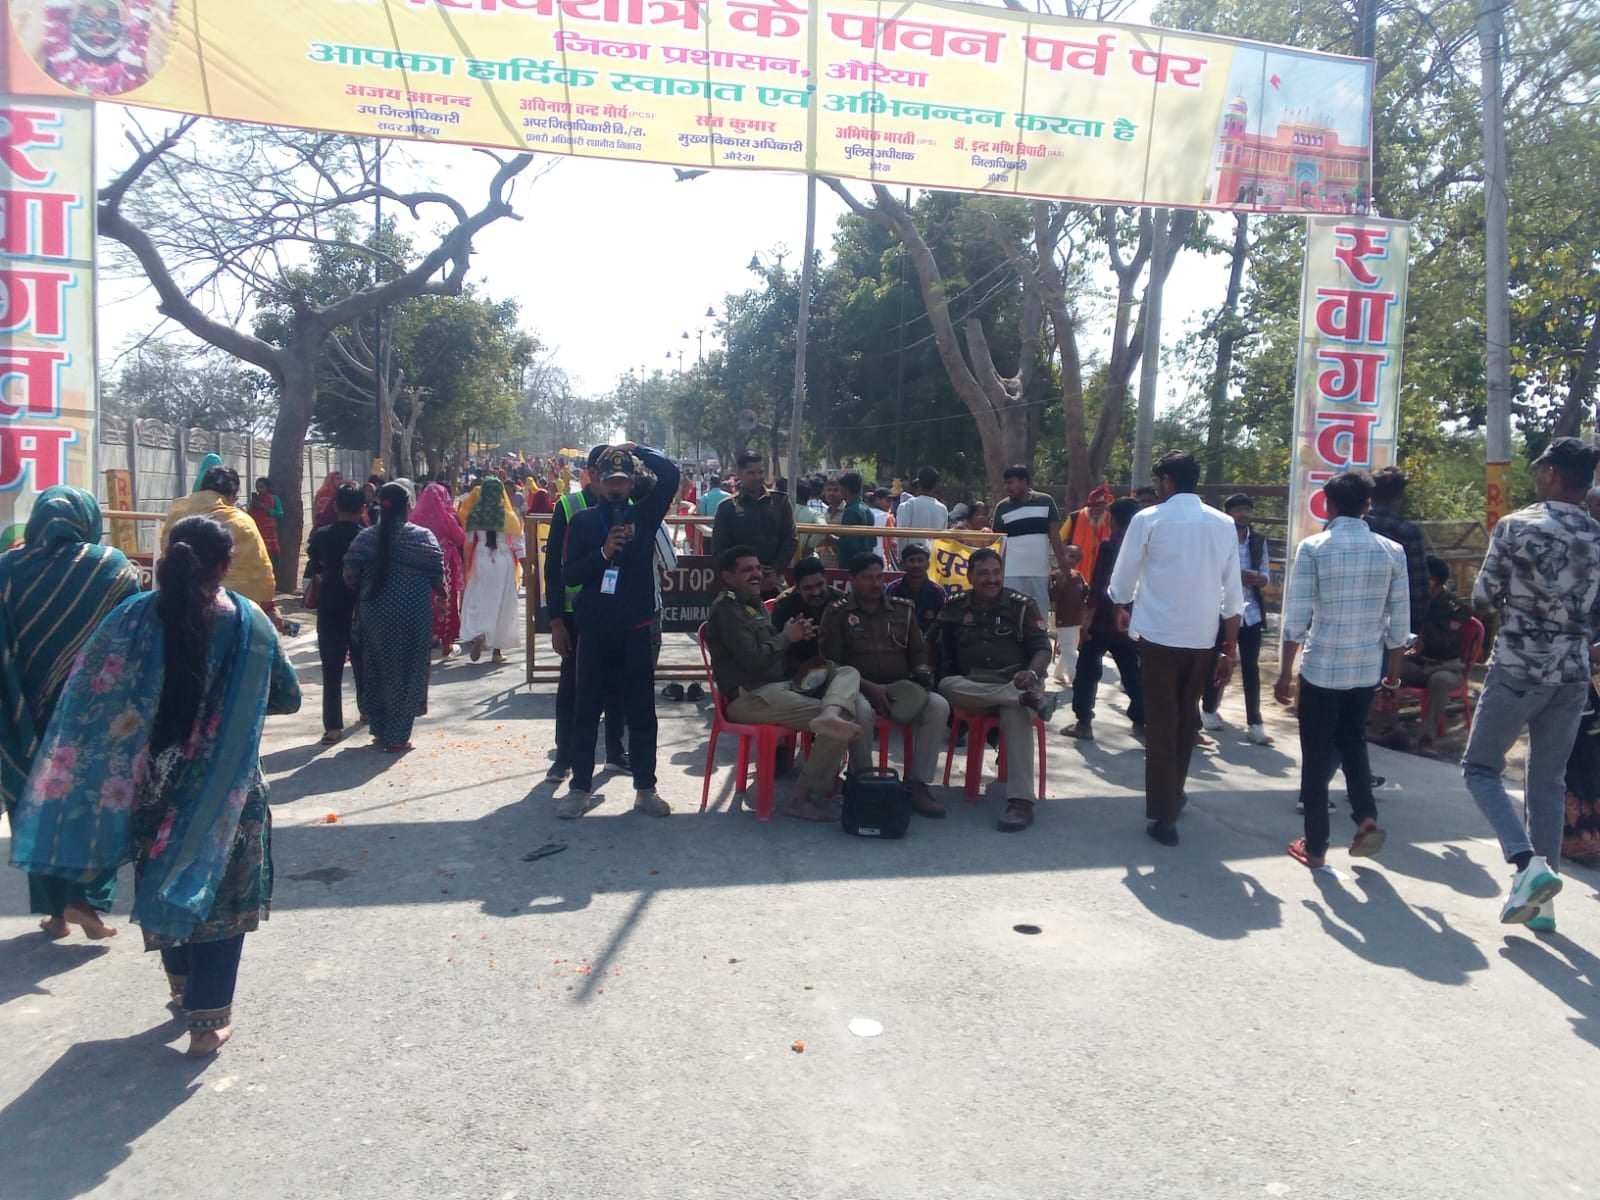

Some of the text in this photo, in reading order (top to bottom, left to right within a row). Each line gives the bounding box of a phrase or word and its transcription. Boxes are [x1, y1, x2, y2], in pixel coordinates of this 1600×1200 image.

[727, 0, 808, 37] के
[827, 12, 1006, 63] पावन
[1021, 34, 1117, 76] पर्व
[1129, 49, 1208, 87] पर
[553, 31, 651, 59] जिला
[661, 46, 811, 77] प्रशासन,
[308, 43, 1139, 142] आपका हार्दिक स्वागत एवं अभिनन्दन करता है
[345, 83, 472, 107] अजय आनन्द
[357, 104, 460, 124] उप जिलाधिकारी
[520, 97, 572, 114] अविनाश
[575, 103, 600, 117] चन्द्र
[522, 116, 548, 128] अपर
[548, 116, 611, 134] जिलाधिकारी
[729, 118, 777, 134] कुमार
[835, 125, 882, 142] अभिषेक
[883, 131, 915, 145] भारती
[678, 132, 803, 152] मुख्य विकास अधिकारी
[844, 143, 916, 161] पुलिस अधीक्षक
[992, 140, 1014, 155] मणि
[1016, 142, 1047, 158] त्रिपाठी
[971, 154, 1027, 171] जिलाधिकारी
[1309, 226, 1395, 522] स्वागत
[662, 567, 715, 592] STOP
